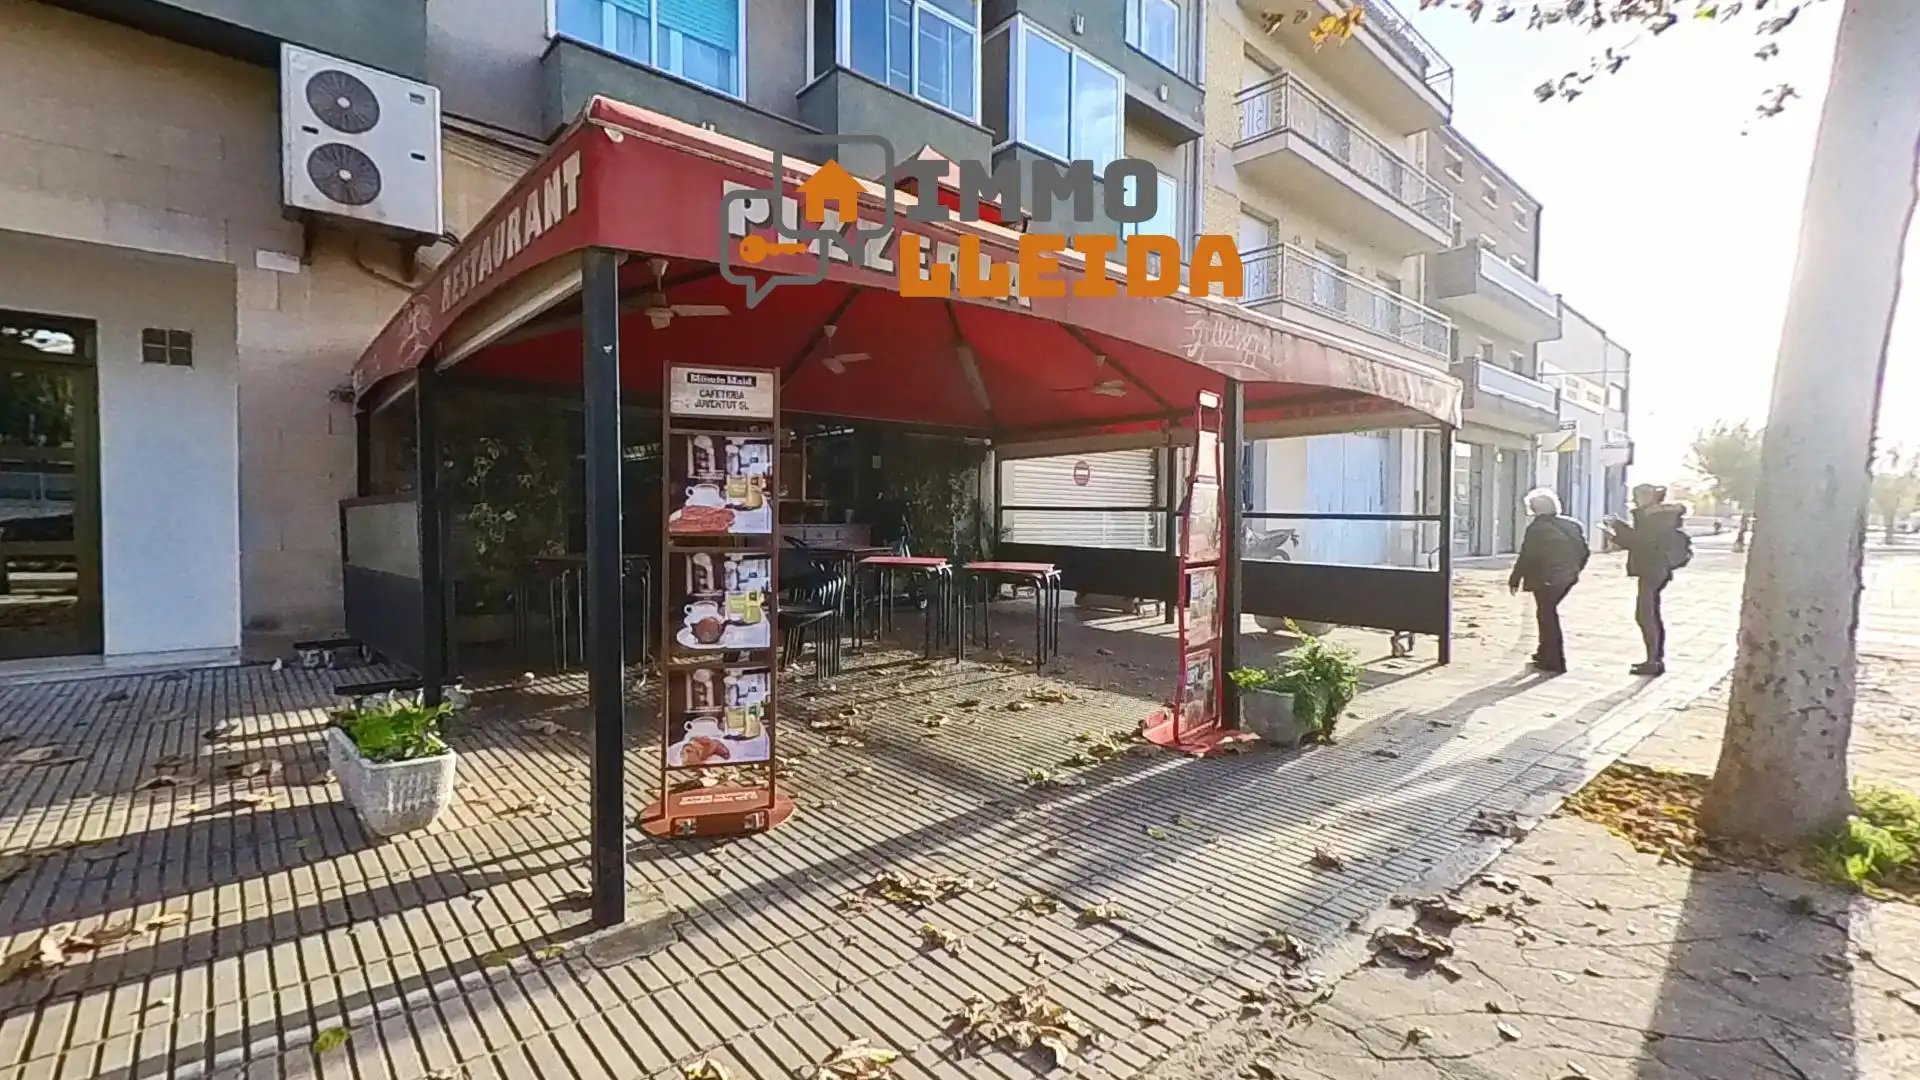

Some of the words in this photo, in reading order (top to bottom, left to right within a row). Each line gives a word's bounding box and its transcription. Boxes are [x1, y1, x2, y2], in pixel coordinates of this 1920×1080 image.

[440, 150, 581, 314] RESTAURANT
[699, 389, 745, 399] CAFETERIA
[694, 400, 737, 410] JUVENTUT
